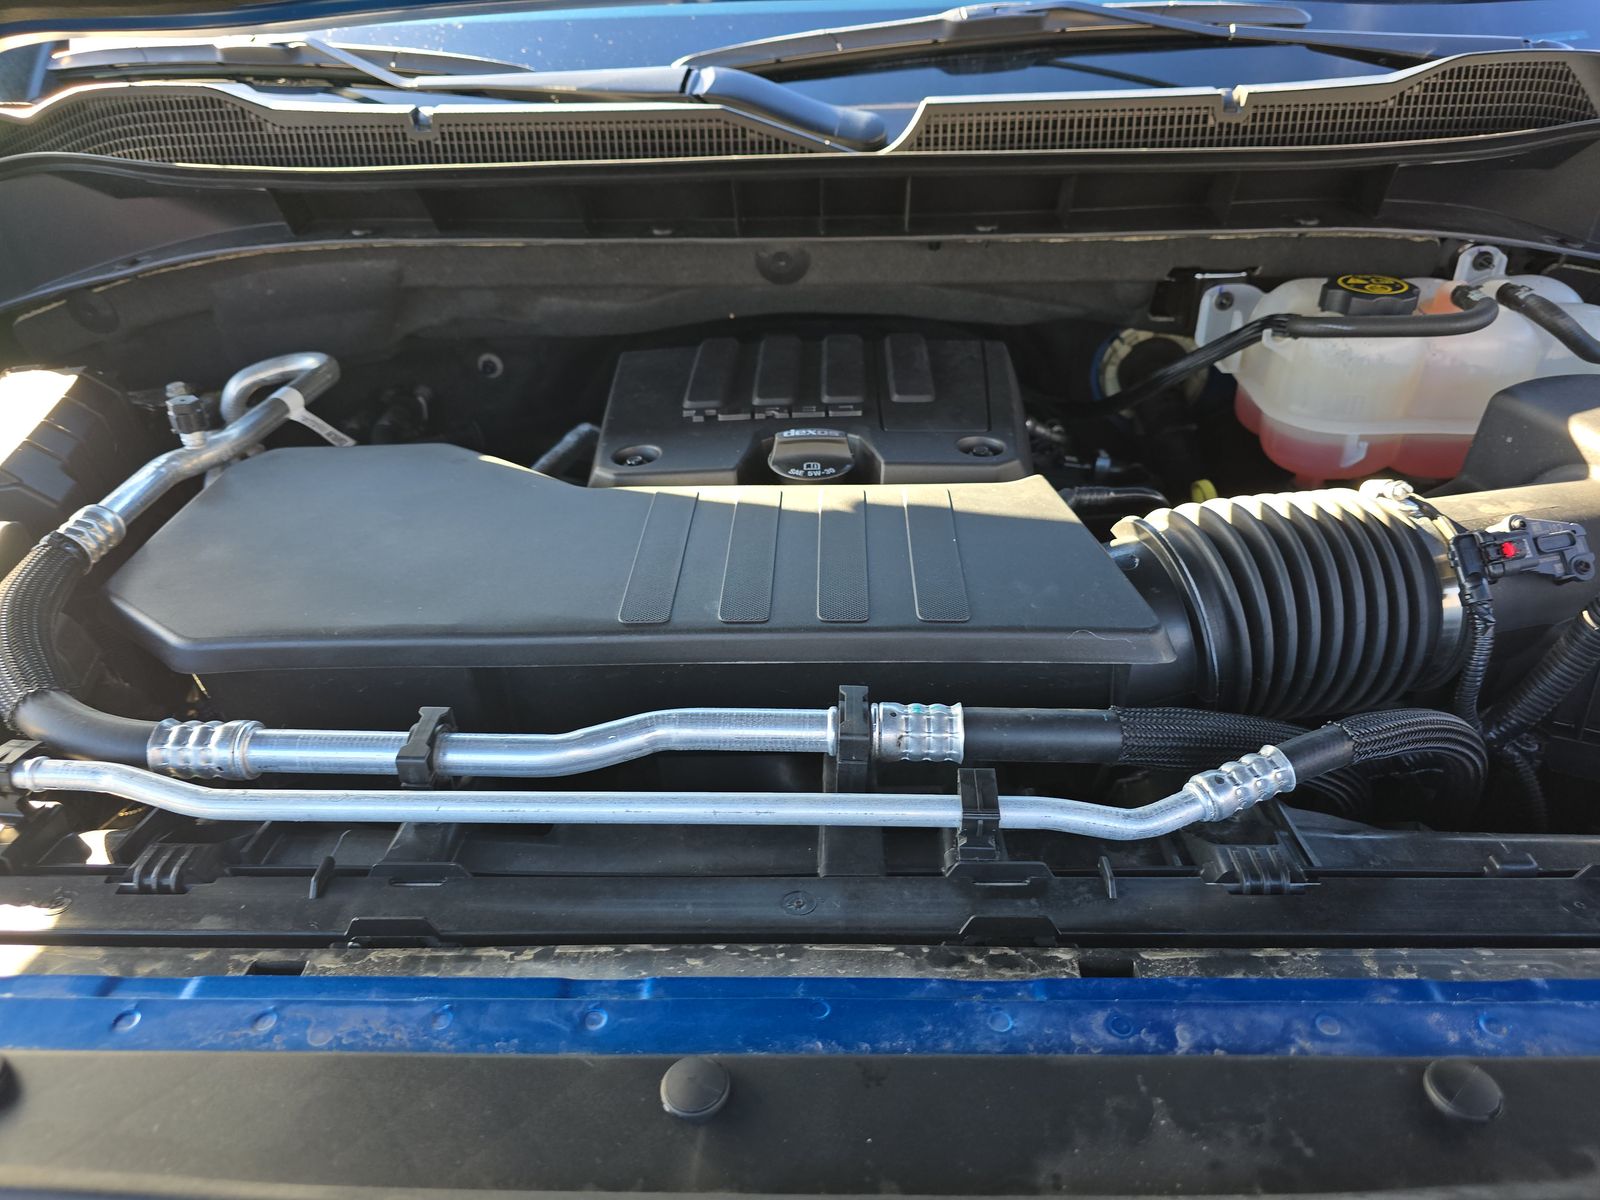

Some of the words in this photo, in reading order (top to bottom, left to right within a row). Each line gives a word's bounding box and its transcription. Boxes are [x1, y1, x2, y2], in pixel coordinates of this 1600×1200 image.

[783, 428, 840, 437] dexos
[787, 468, 805, 476] SAE
[807, 467, 836, 477] 5W-30
